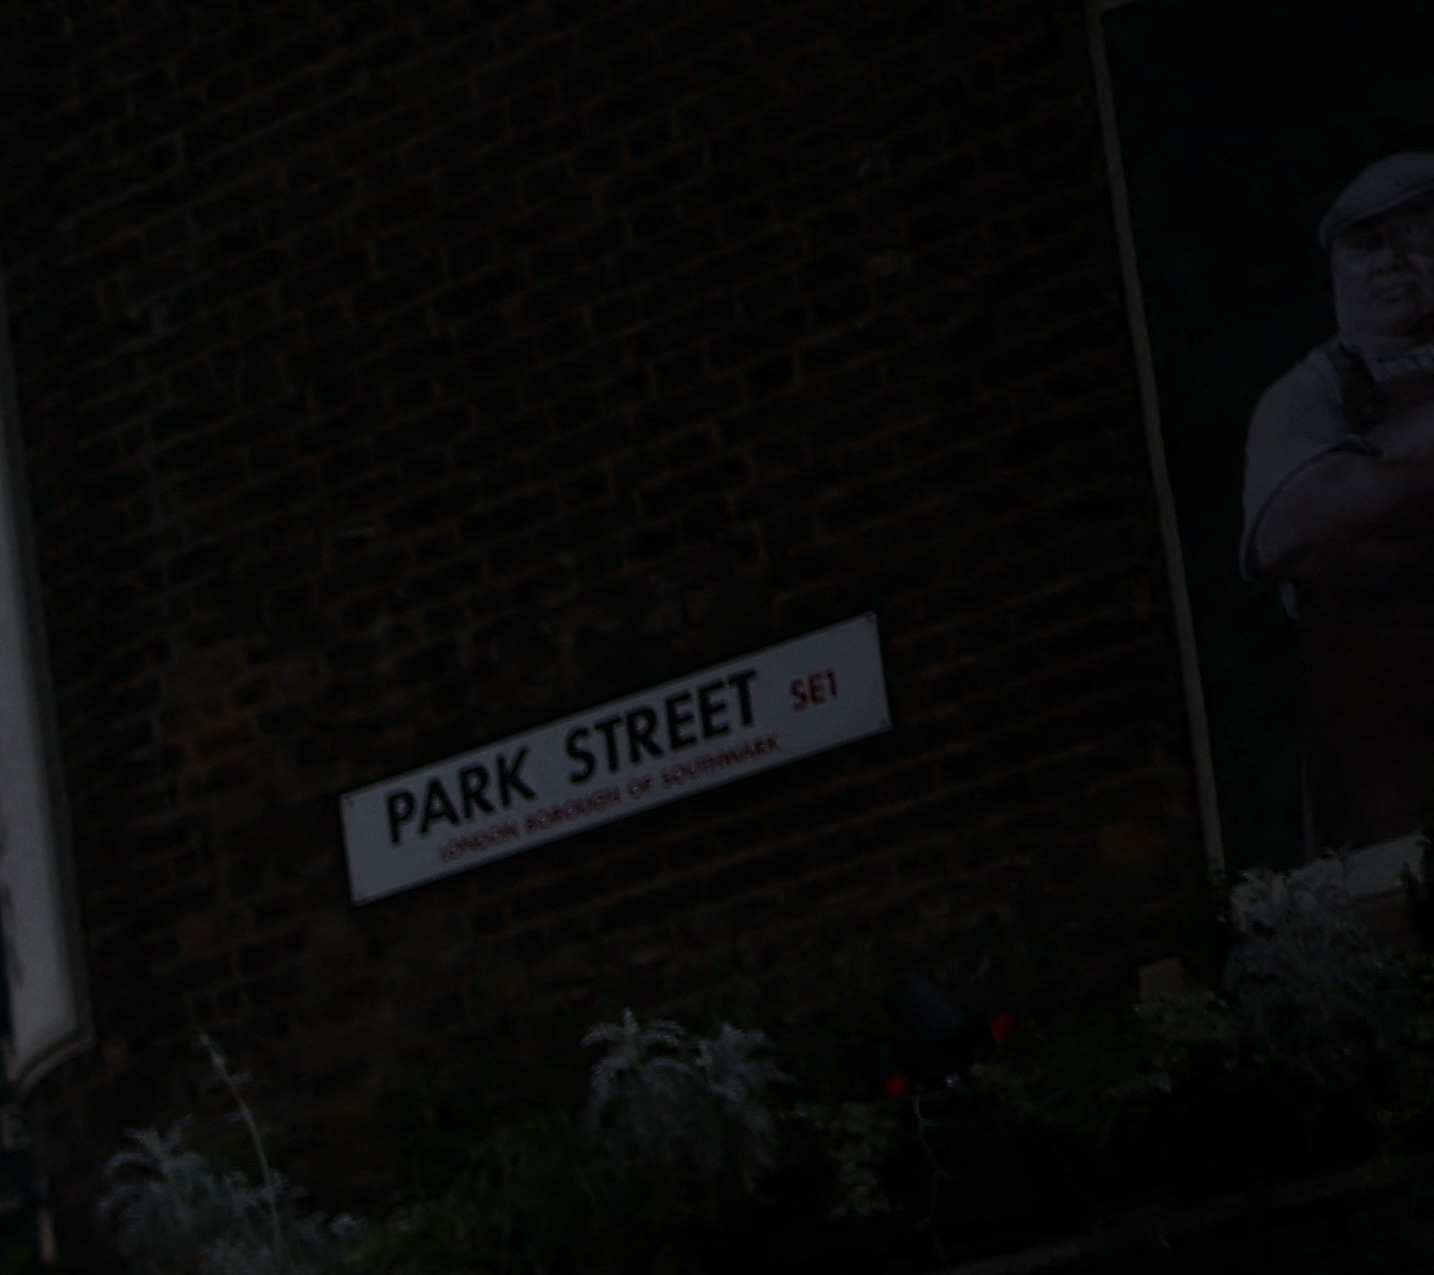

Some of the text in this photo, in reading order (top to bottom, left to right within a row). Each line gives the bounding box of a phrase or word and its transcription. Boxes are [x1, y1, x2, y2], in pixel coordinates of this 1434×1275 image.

[385, 669, 838, 846] PARK STREET SE1
[438, 734, 782, 863] LONDON BOROUGH OF SOUTHWARK
